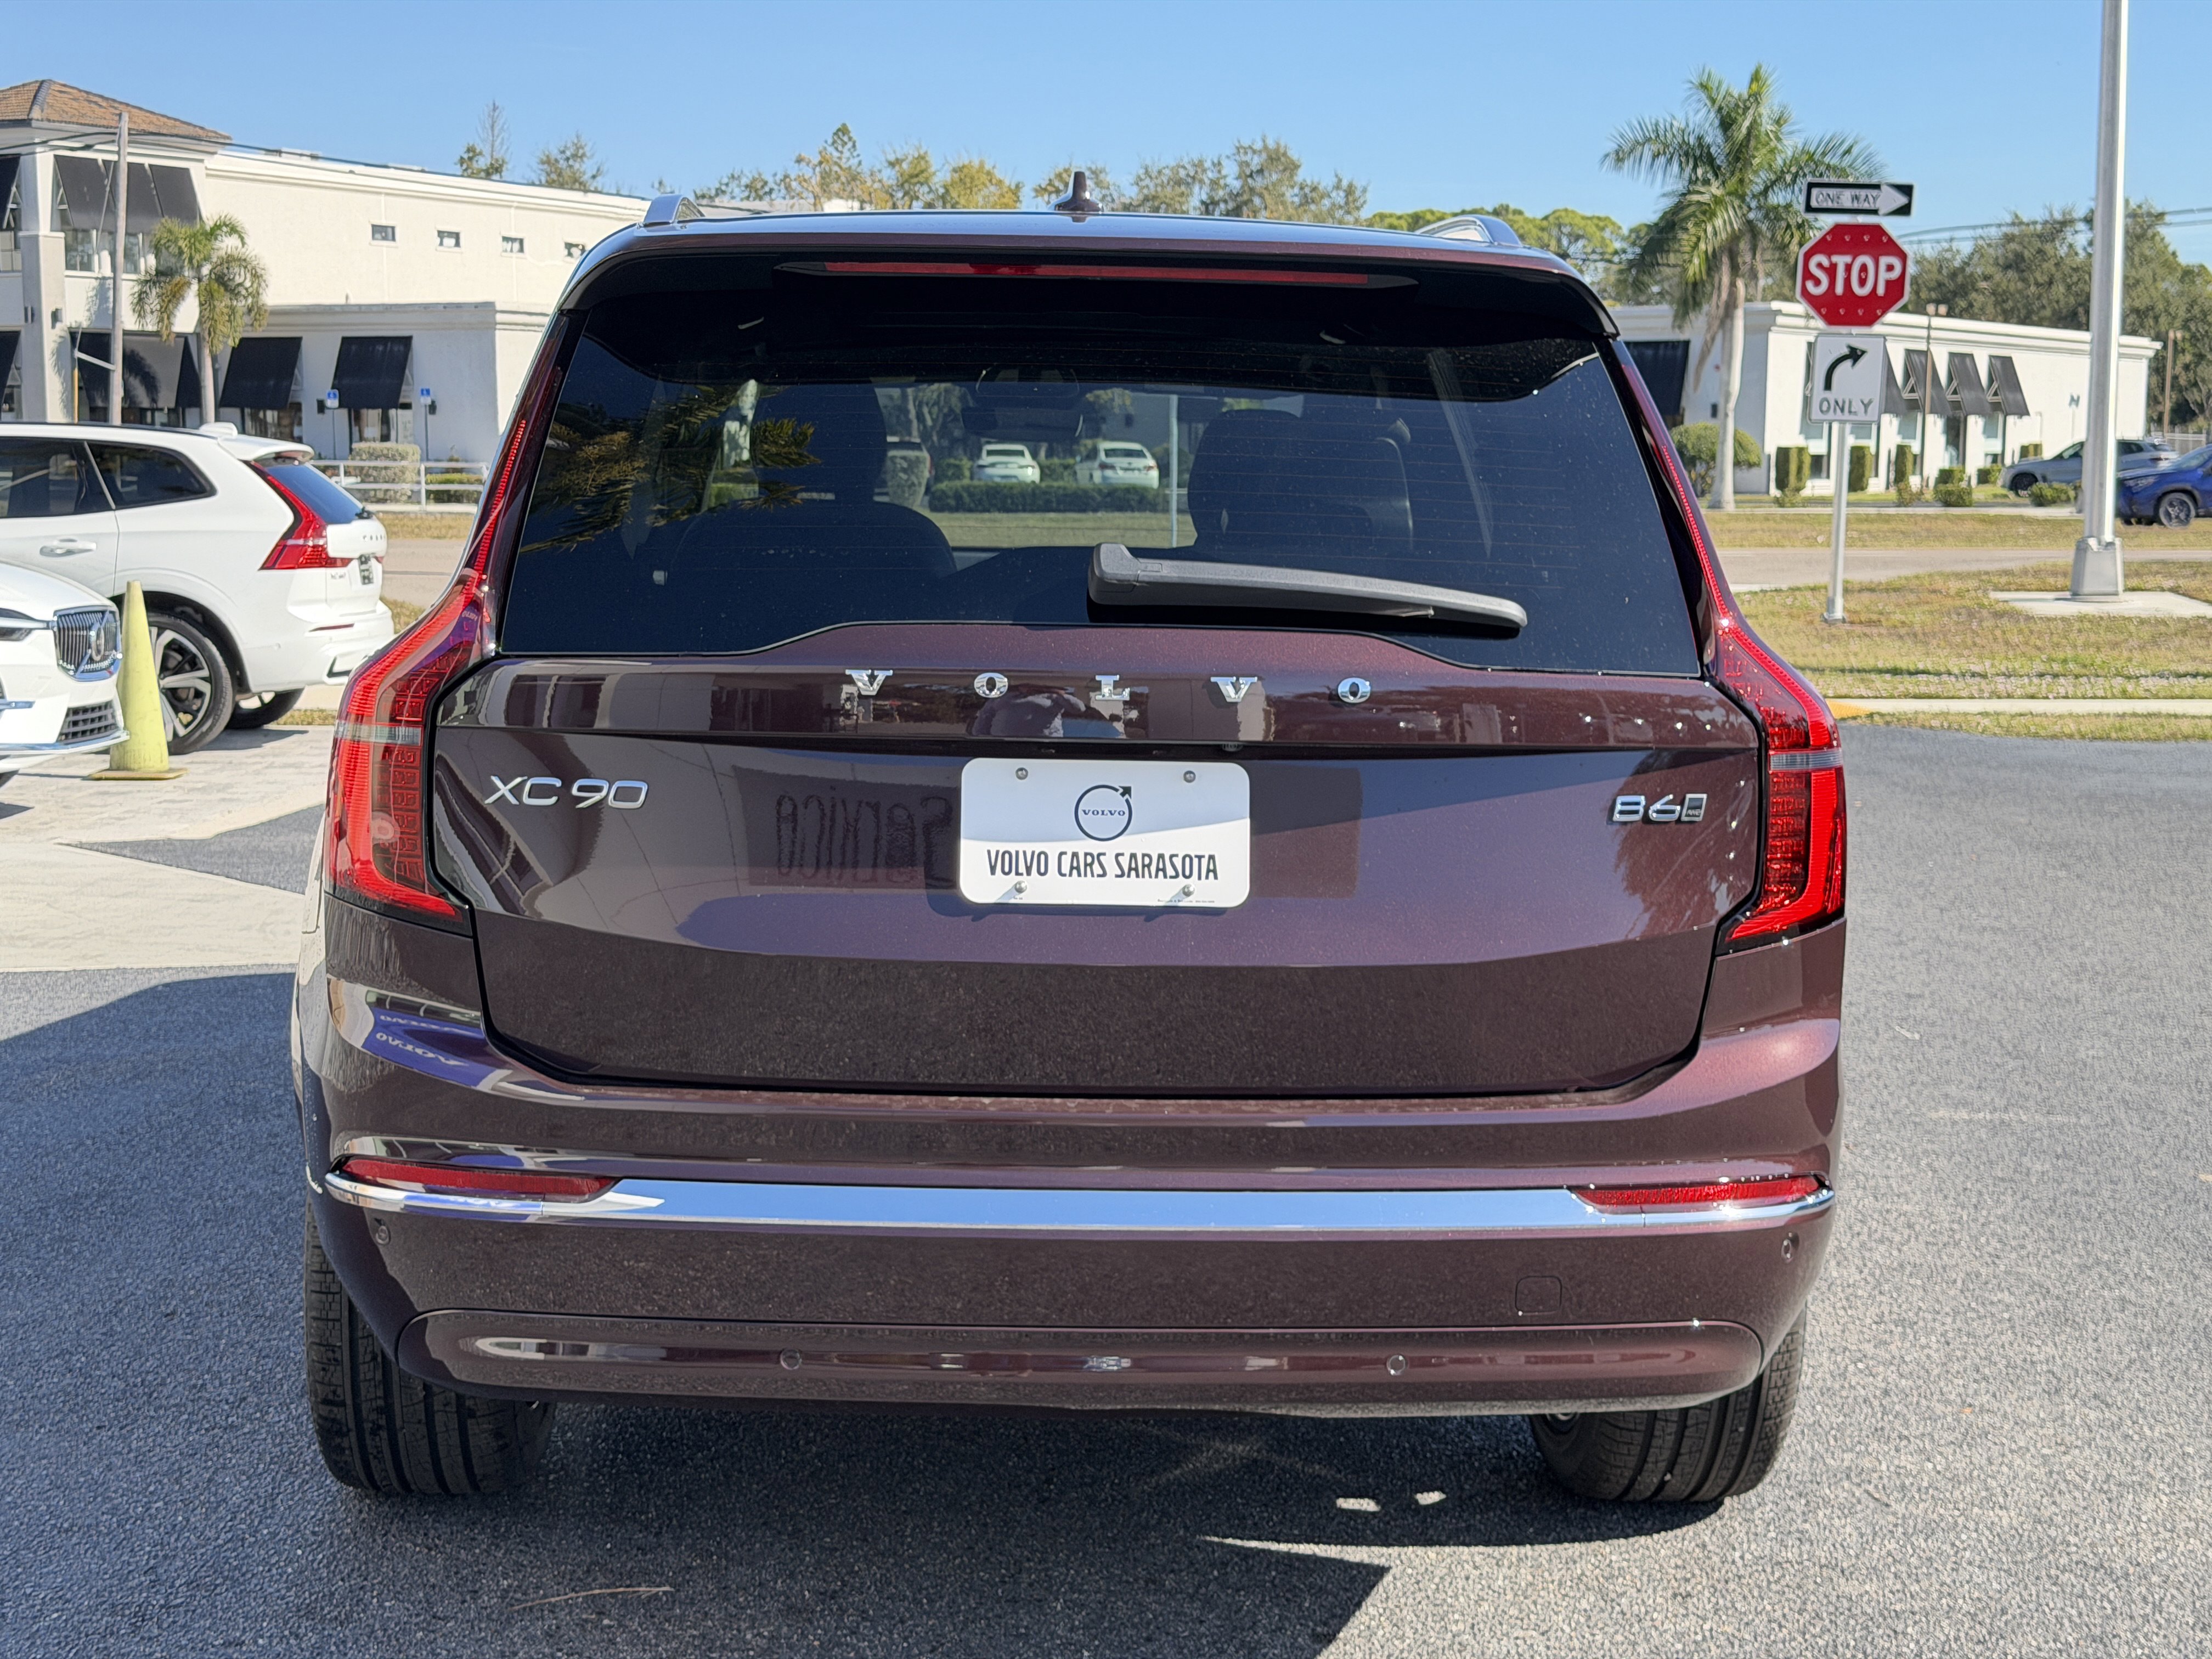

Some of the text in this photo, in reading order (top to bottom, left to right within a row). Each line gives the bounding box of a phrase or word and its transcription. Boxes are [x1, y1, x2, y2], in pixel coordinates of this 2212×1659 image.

[1815, 191, 1881, 208] ONE WAY
[1805, 253, 1903, 297] STOP
[1819, 397, 1875, 416] ONLY
[845, 669, 1372, 704] VOLVO
[1612, 794, 1681, 822] B6
[986, 849, 1219, 881] VOLVO CARS SARASOTA
